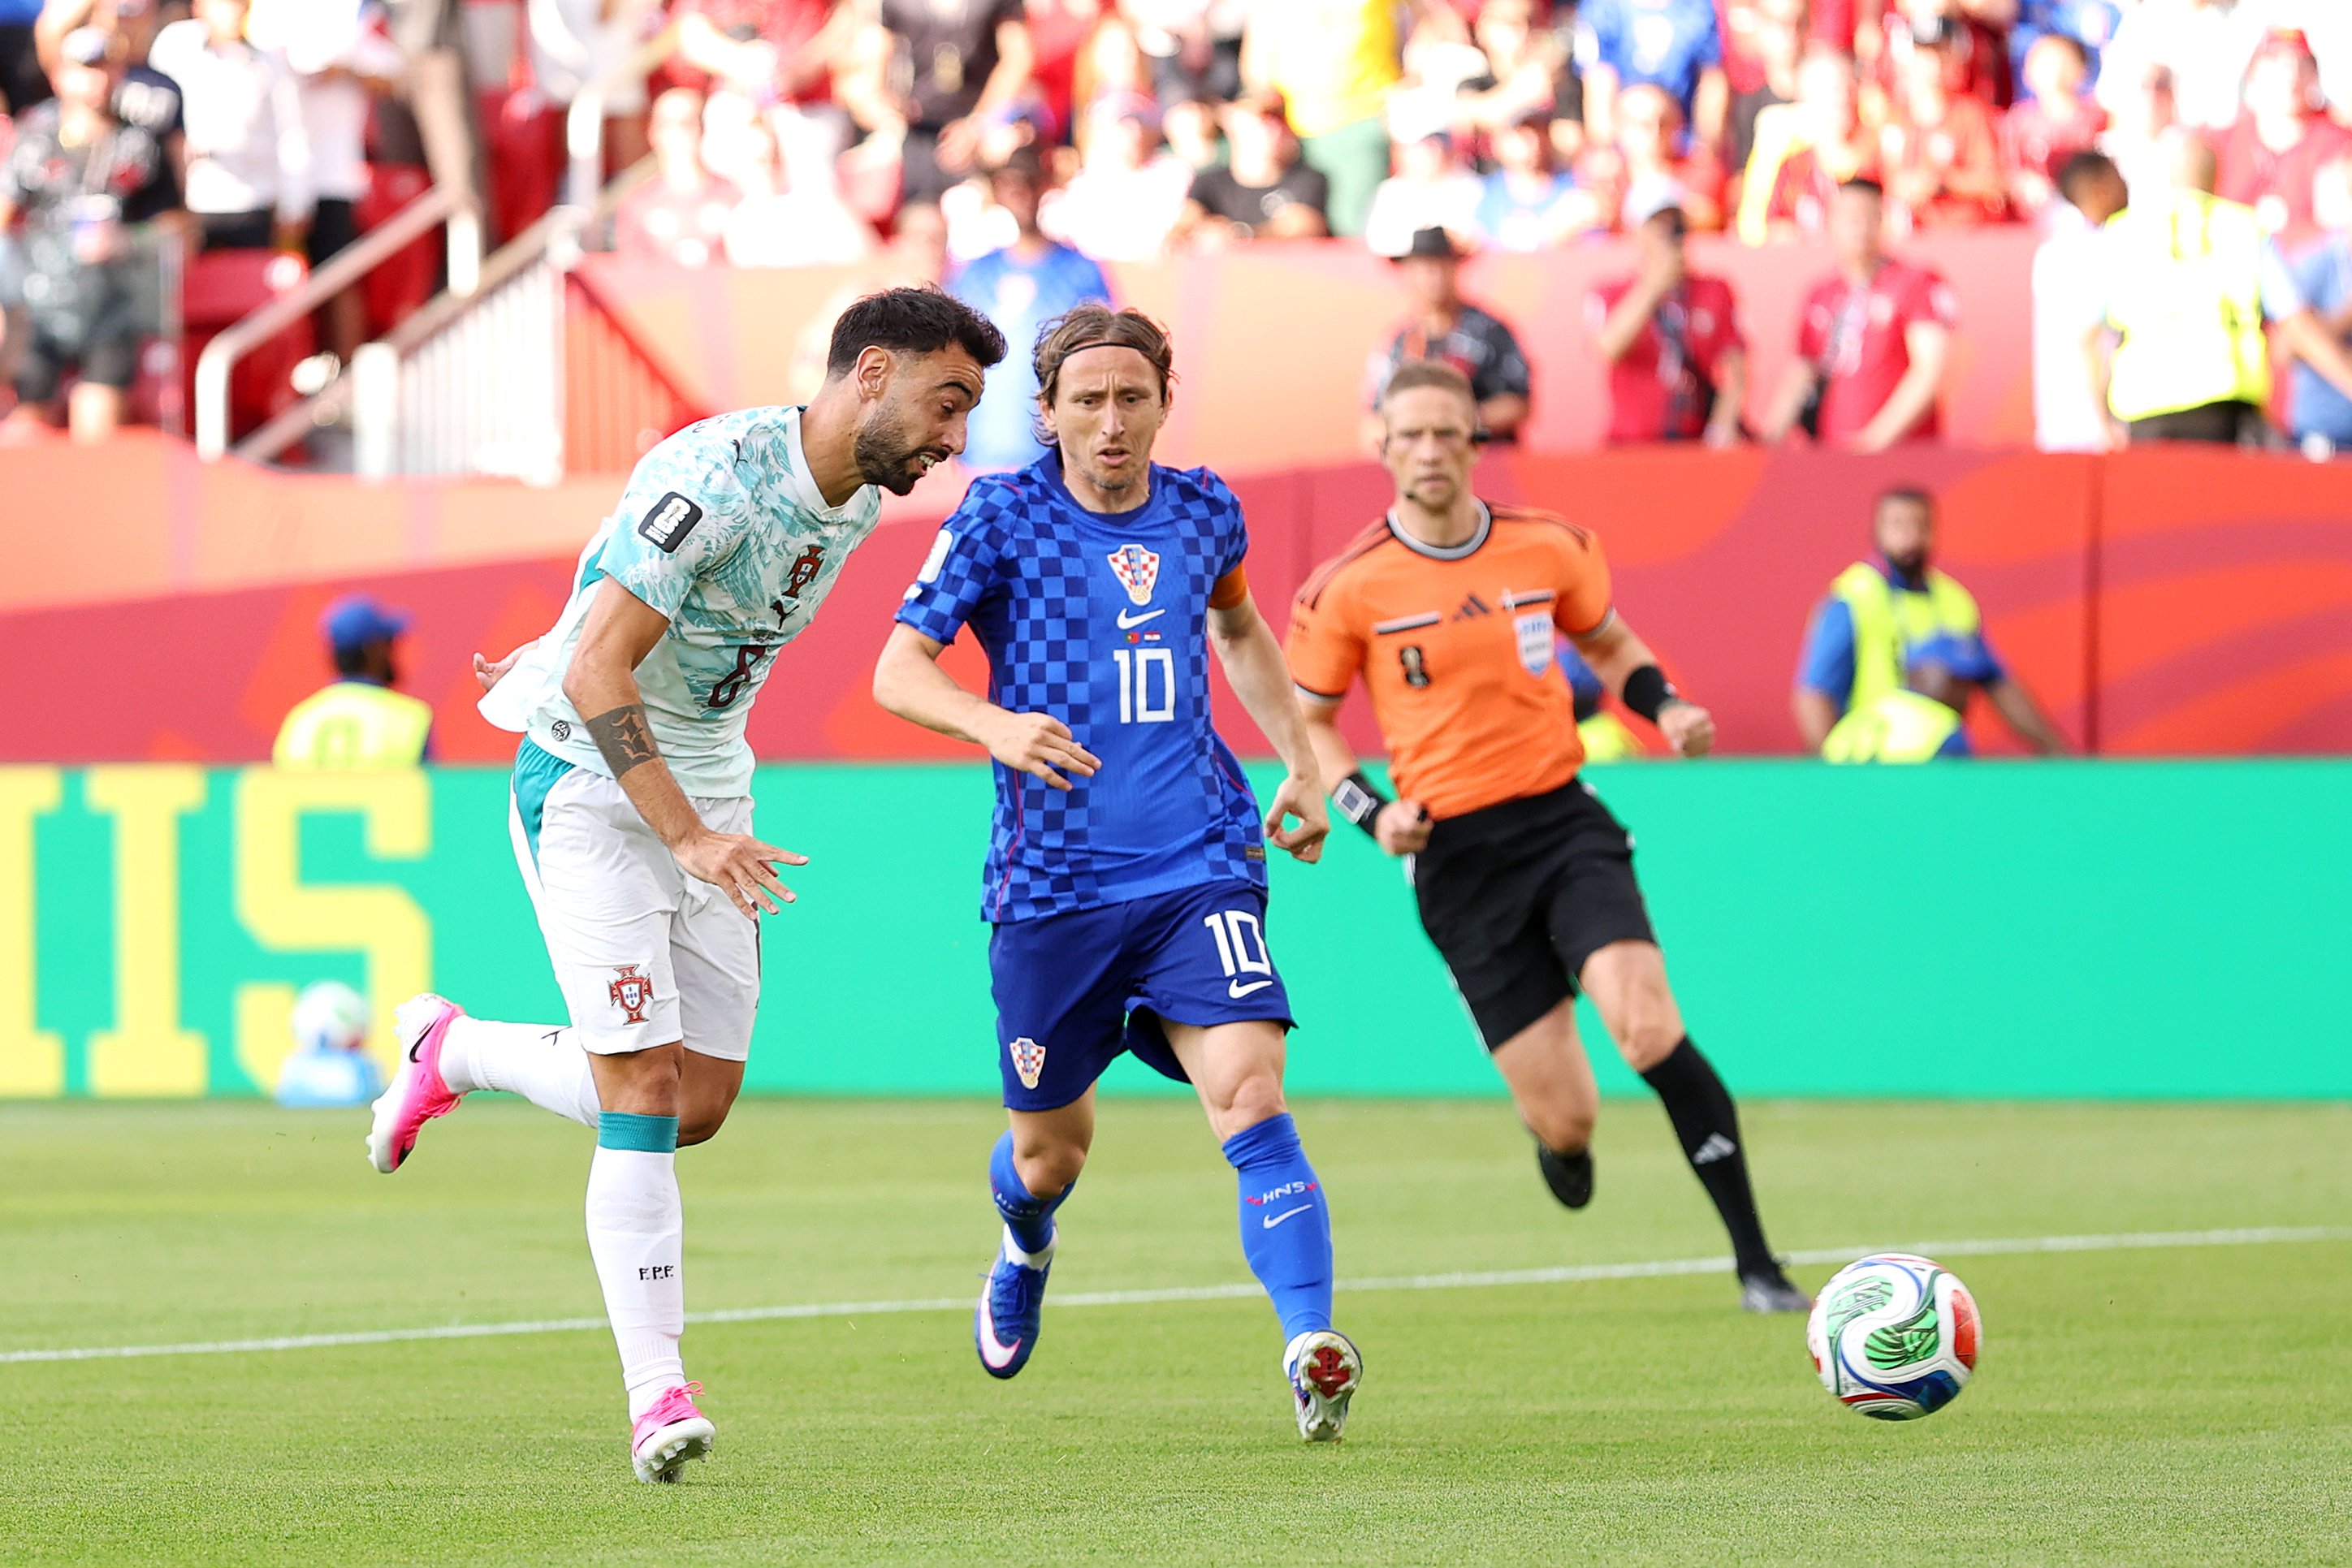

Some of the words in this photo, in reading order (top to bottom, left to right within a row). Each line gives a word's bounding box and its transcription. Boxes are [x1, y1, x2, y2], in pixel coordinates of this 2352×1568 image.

[708, 644, 767, 708] 8
[1113, 648, 1176, 724] 10
[1204, 909, 1272, 977] 10
[1263, 1181, 1306, 1204] HNS
